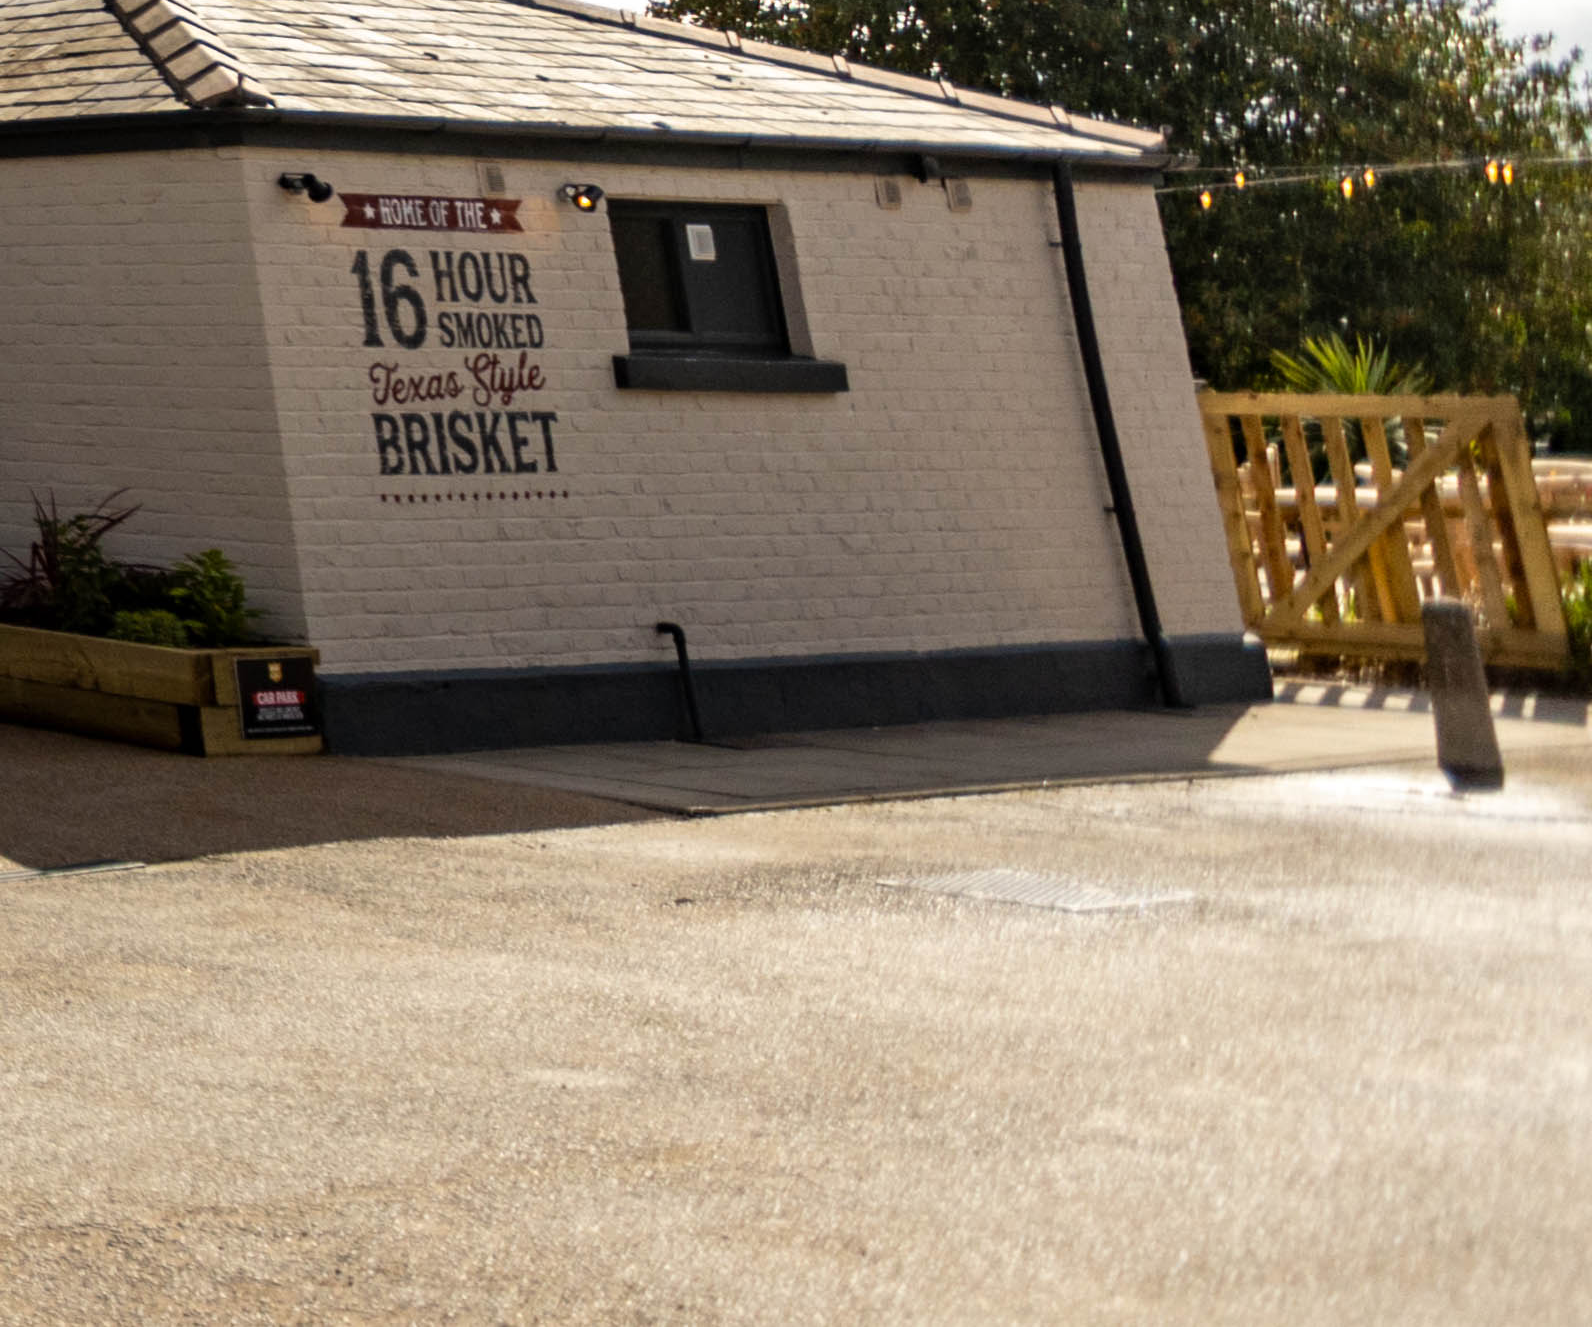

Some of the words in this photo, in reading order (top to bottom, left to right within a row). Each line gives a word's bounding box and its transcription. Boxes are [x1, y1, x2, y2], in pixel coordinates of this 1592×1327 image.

[379, 197, 427, 226] HOME
[429, 199, 450, 228] OF
[455, 200, 488, 229] THE
[351, 249, 428, 350] 16
[429, 250, 538, 304] HOUR
[437, 312, 544, 349] SMOKED
[369, 362, 464, 405] Texas
[464, 351, 546, 407] Style
[371, 410, 558, 475] BRISKET
